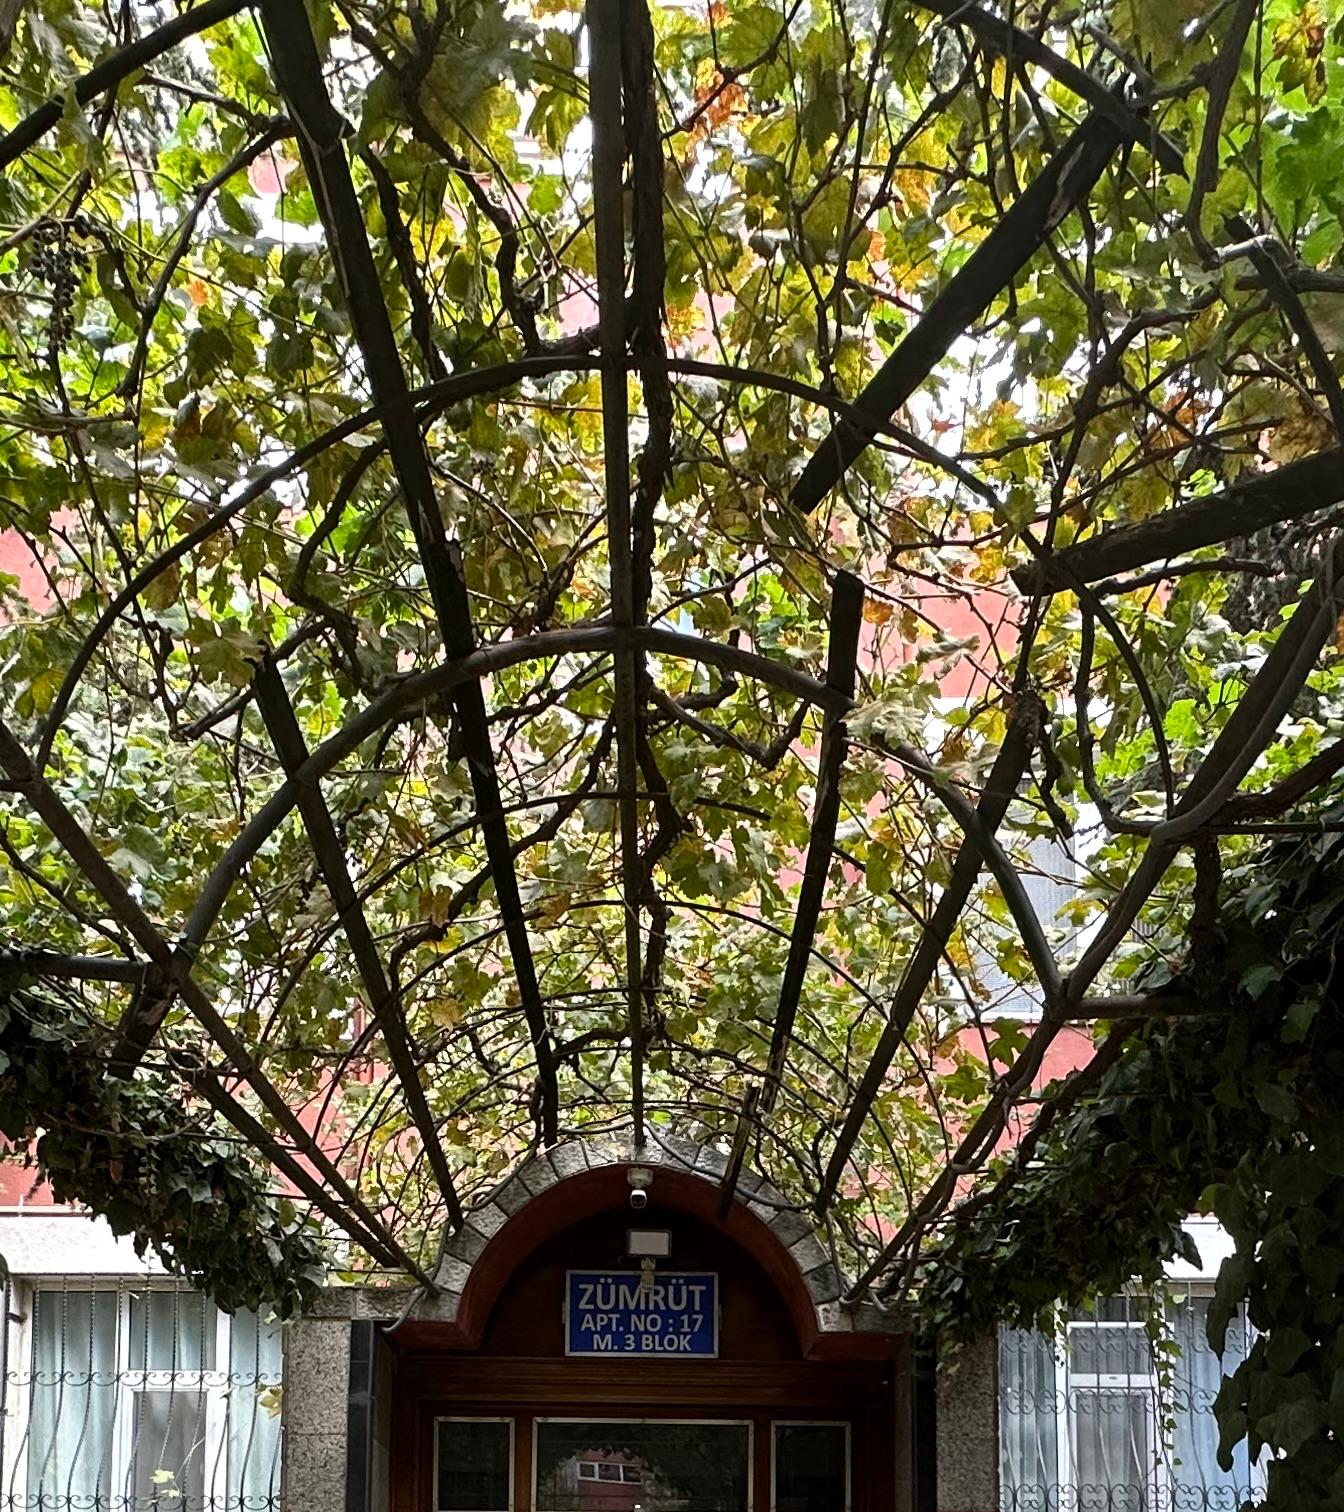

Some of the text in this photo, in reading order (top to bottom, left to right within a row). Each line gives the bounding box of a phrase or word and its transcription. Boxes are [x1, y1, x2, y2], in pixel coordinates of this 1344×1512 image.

[578, 1277, 707, 1311] ZÜMRÜT
[581, 1313, 624, 1332] APT.
[631, 1313, 662, 1332] NO
[680, 1313, 704, 1332] 17
[593, 1334, 692, 1351] M. 3 BLOK
